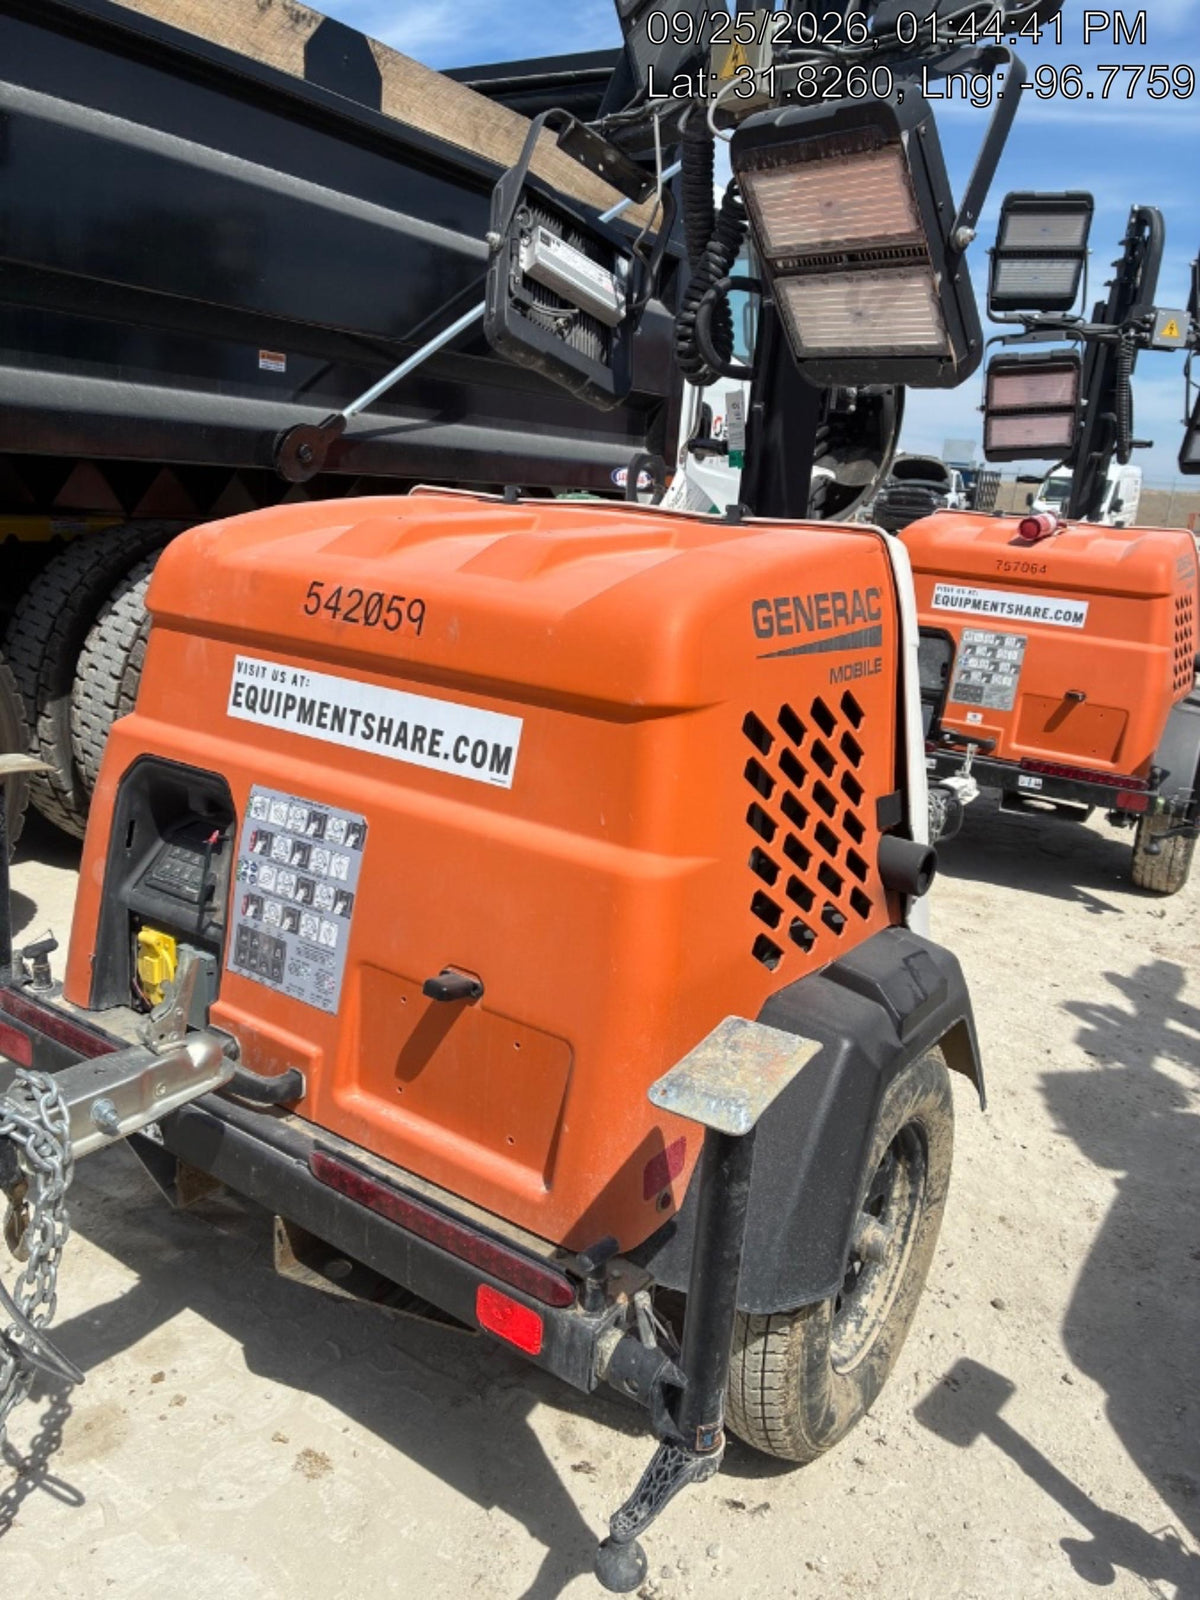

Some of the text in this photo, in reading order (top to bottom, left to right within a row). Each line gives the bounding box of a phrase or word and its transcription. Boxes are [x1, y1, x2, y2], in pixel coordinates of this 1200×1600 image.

[995, 559, 1048, 575] 757064
[303, 580, 426, 637] 542059
[751, 586, 882, 639] GENERAC
[933, 594, 1084, 624] EQUIPMENTSHARE.COM
[236, 661, 311, 688] VISIT US AT:
[829, 657, 882, 685] MOBILE
[231, 681, 513, 776] EQUIPMENTSHARE.COM
